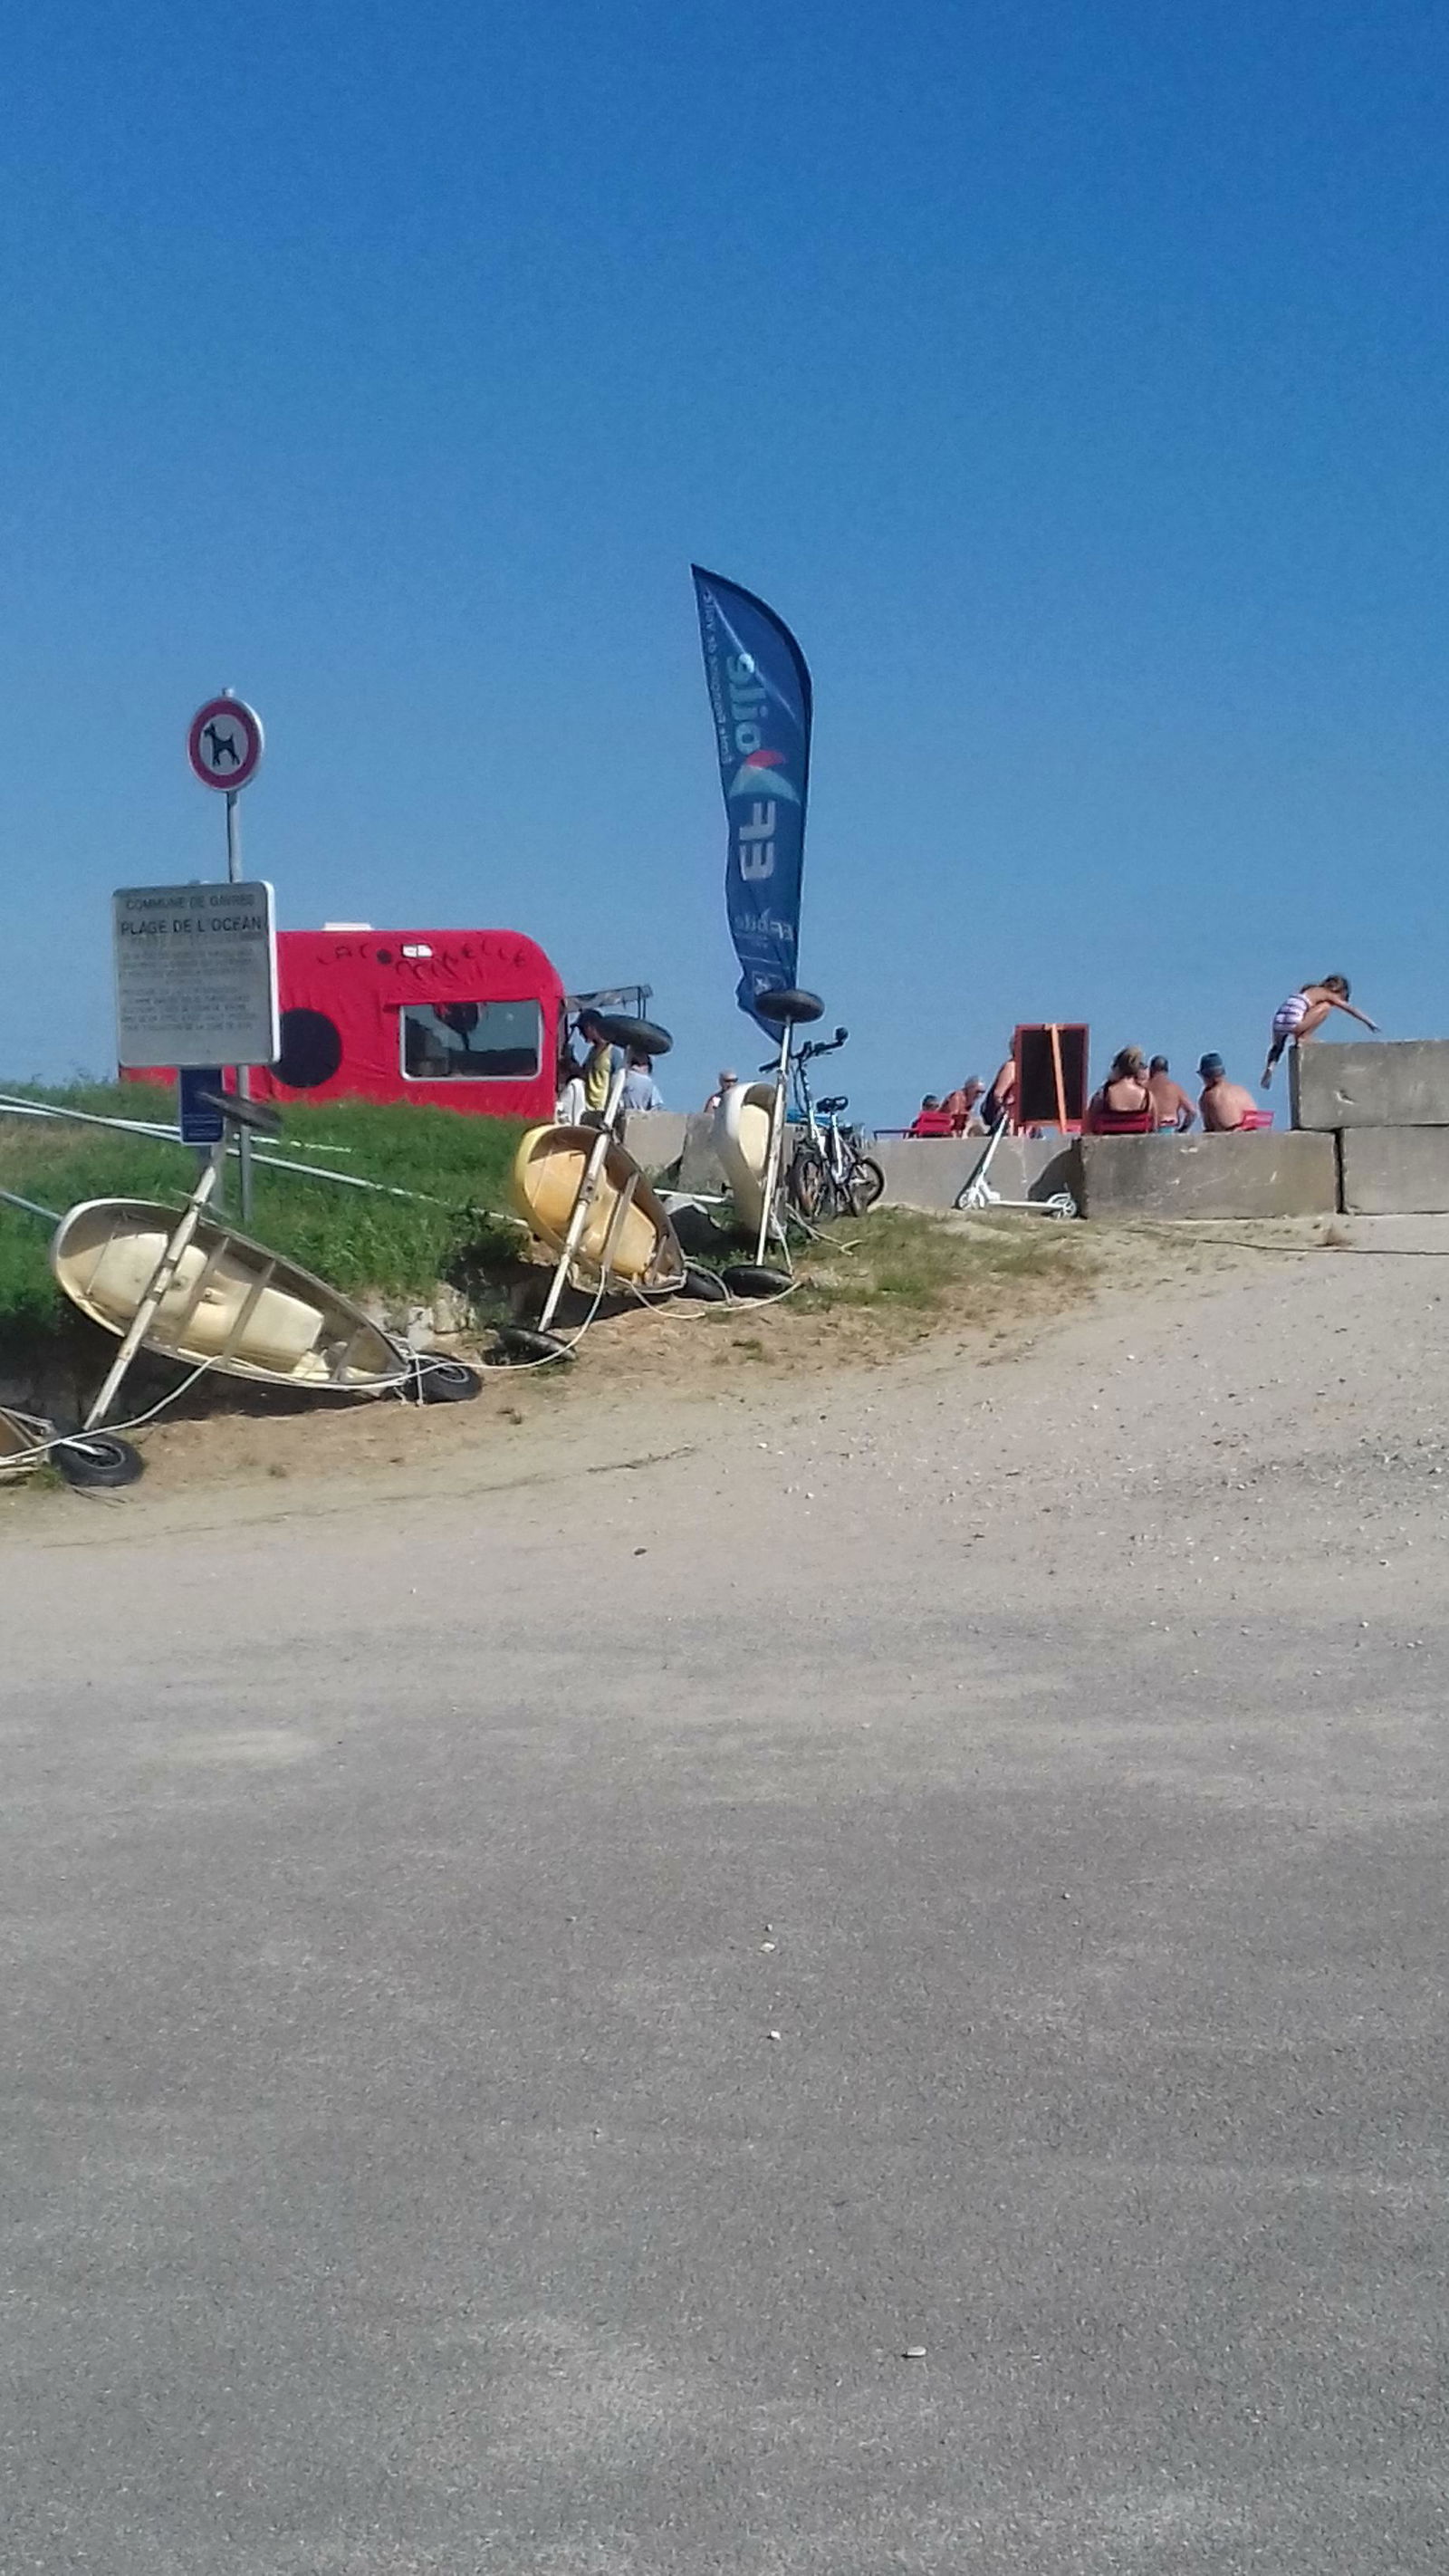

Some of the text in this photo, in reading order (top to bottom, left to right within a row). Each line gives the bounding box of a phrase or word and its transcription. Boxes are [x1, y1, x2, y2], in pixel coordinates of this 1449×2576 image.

[189, 896, 205, 908] DE
[120, 918, 168, 935] PLAGE
[172, 918, 192, 934] DE
